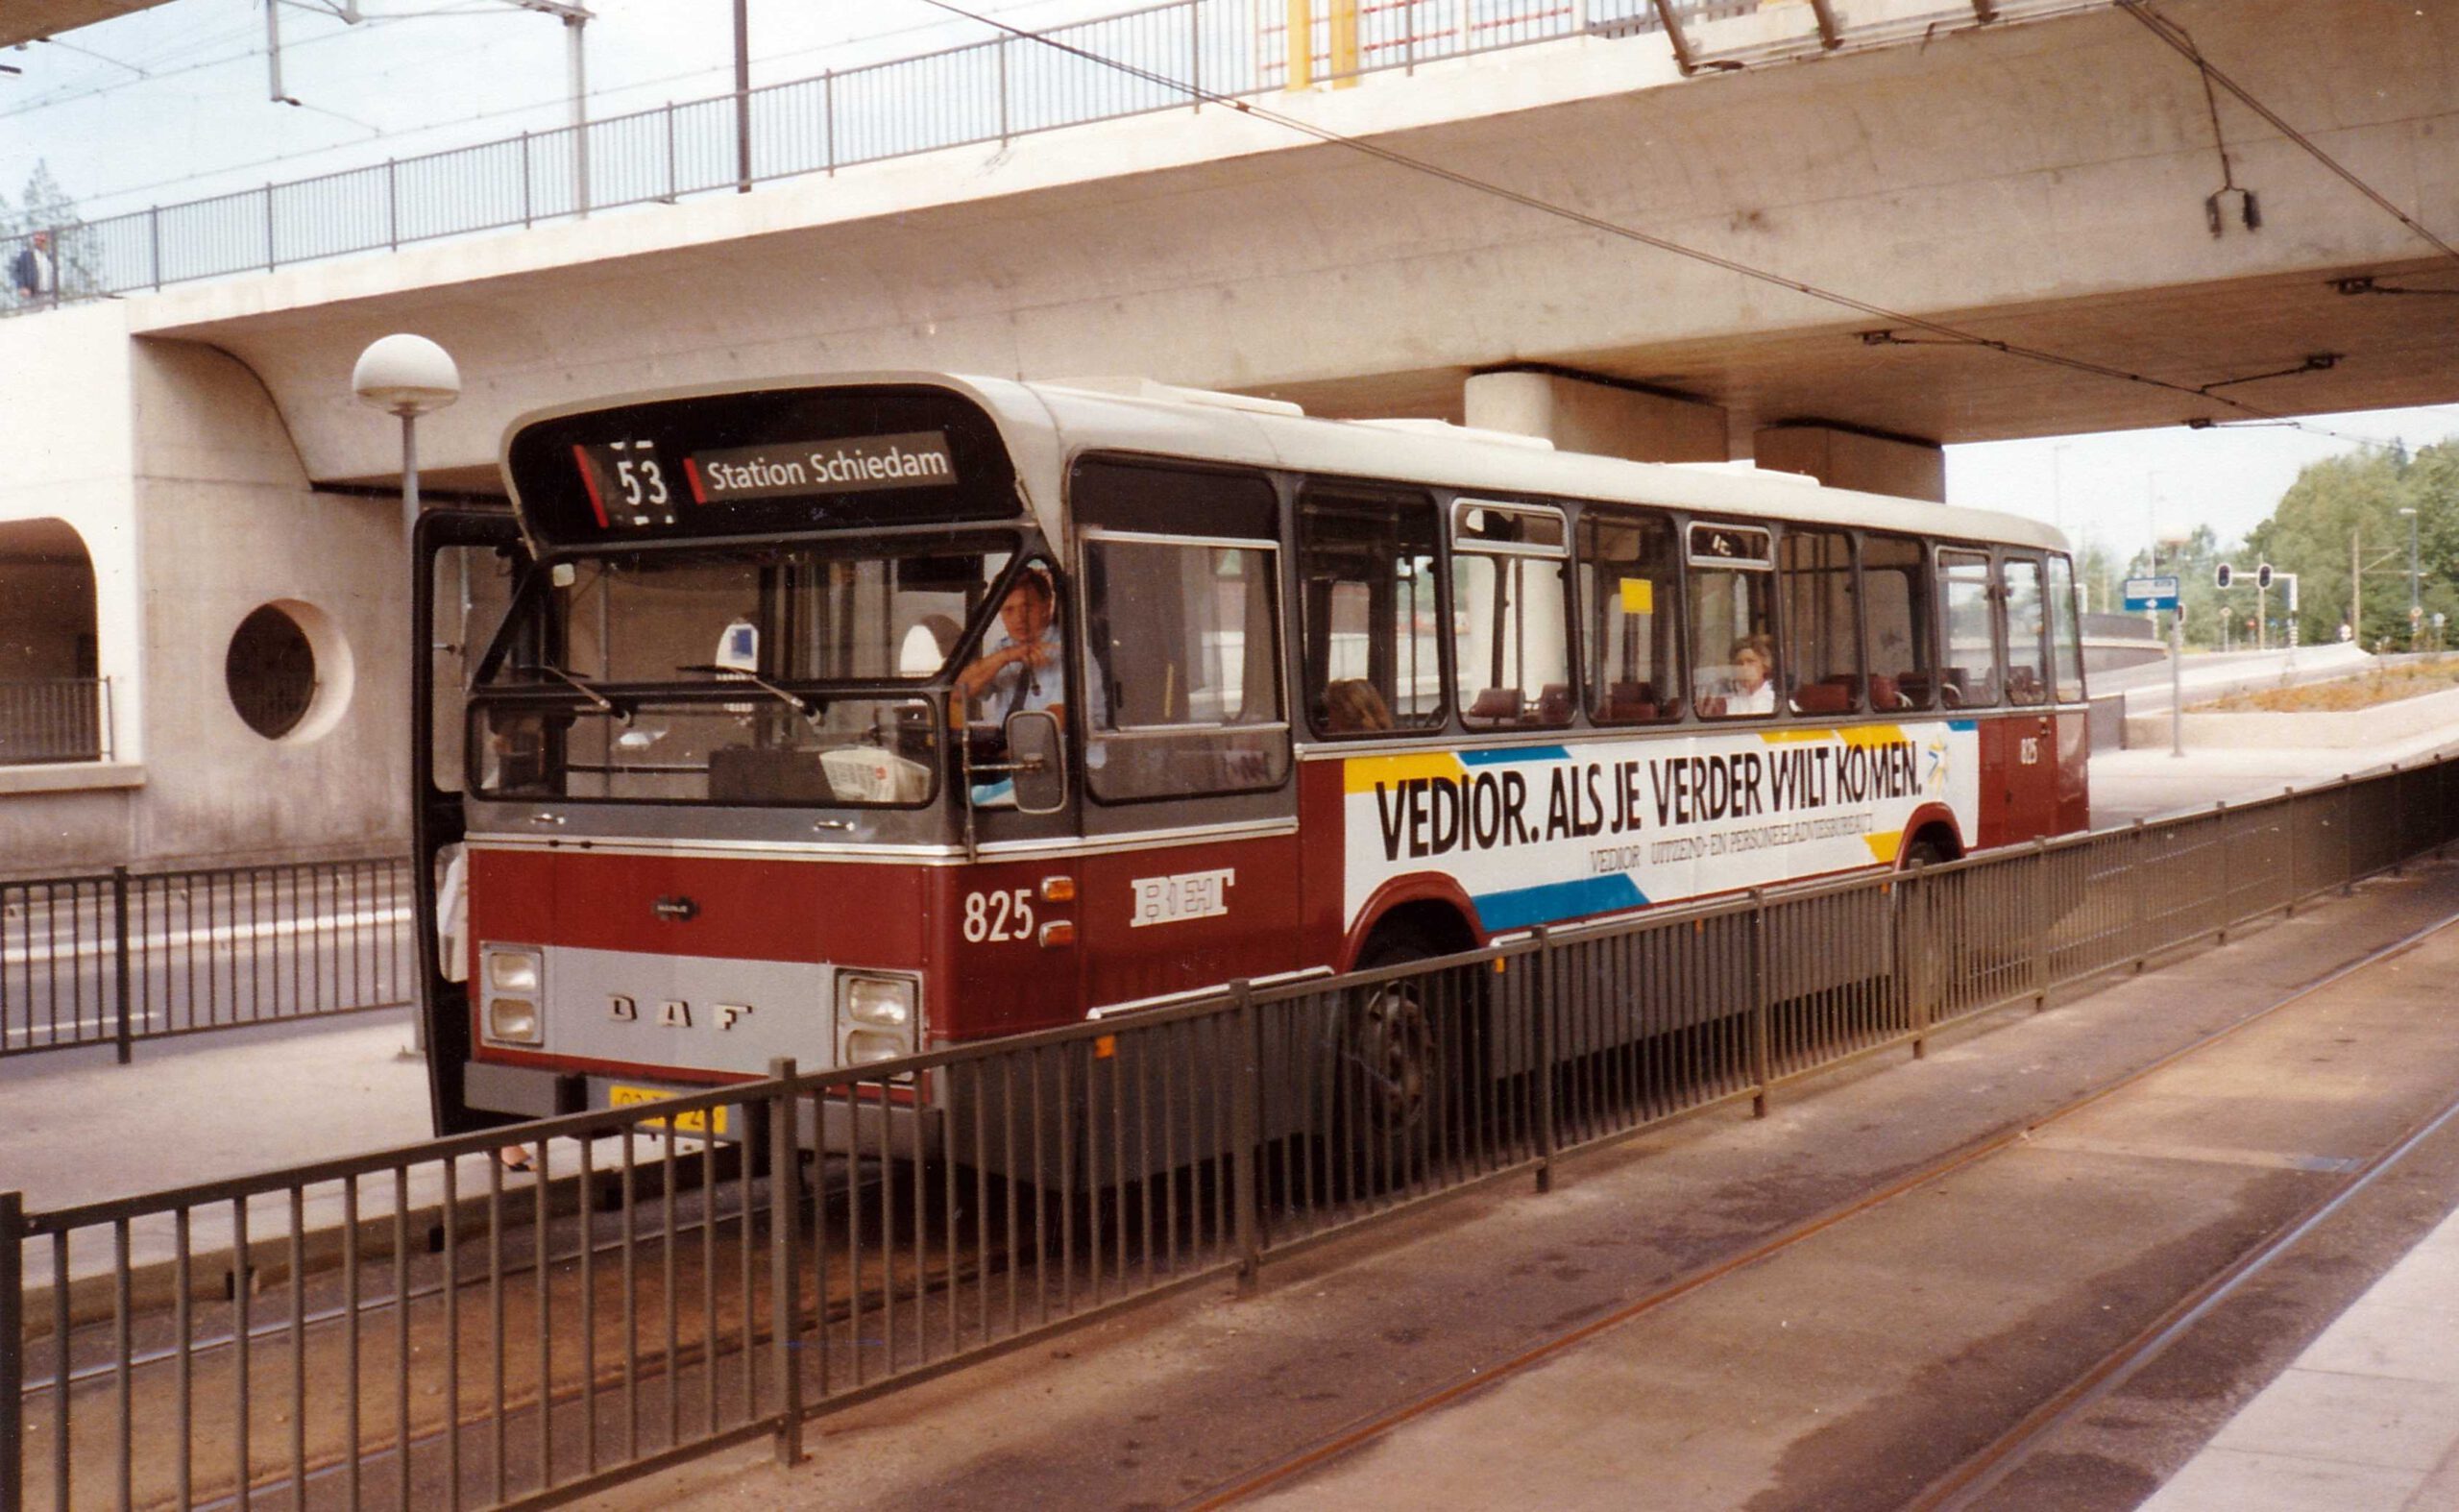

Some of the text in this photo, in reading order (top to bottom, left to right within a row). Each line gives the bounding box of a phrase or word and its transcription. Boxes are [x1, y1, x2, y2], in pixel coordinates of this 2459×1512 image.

[617, 460, 668, 505] 53
[707, 446, 949, 491] Station Schiedam
[1375, 741, 1922, 862] VEDIOR. ALS JE VERDER WILT KOMEN.
[1590, 844, 1640, 872] VEDIOR
[1710, 832, 1727, 856] EN
[962, 889, 1034, 943] 825
[608, 992, 753, 1031] DAF
